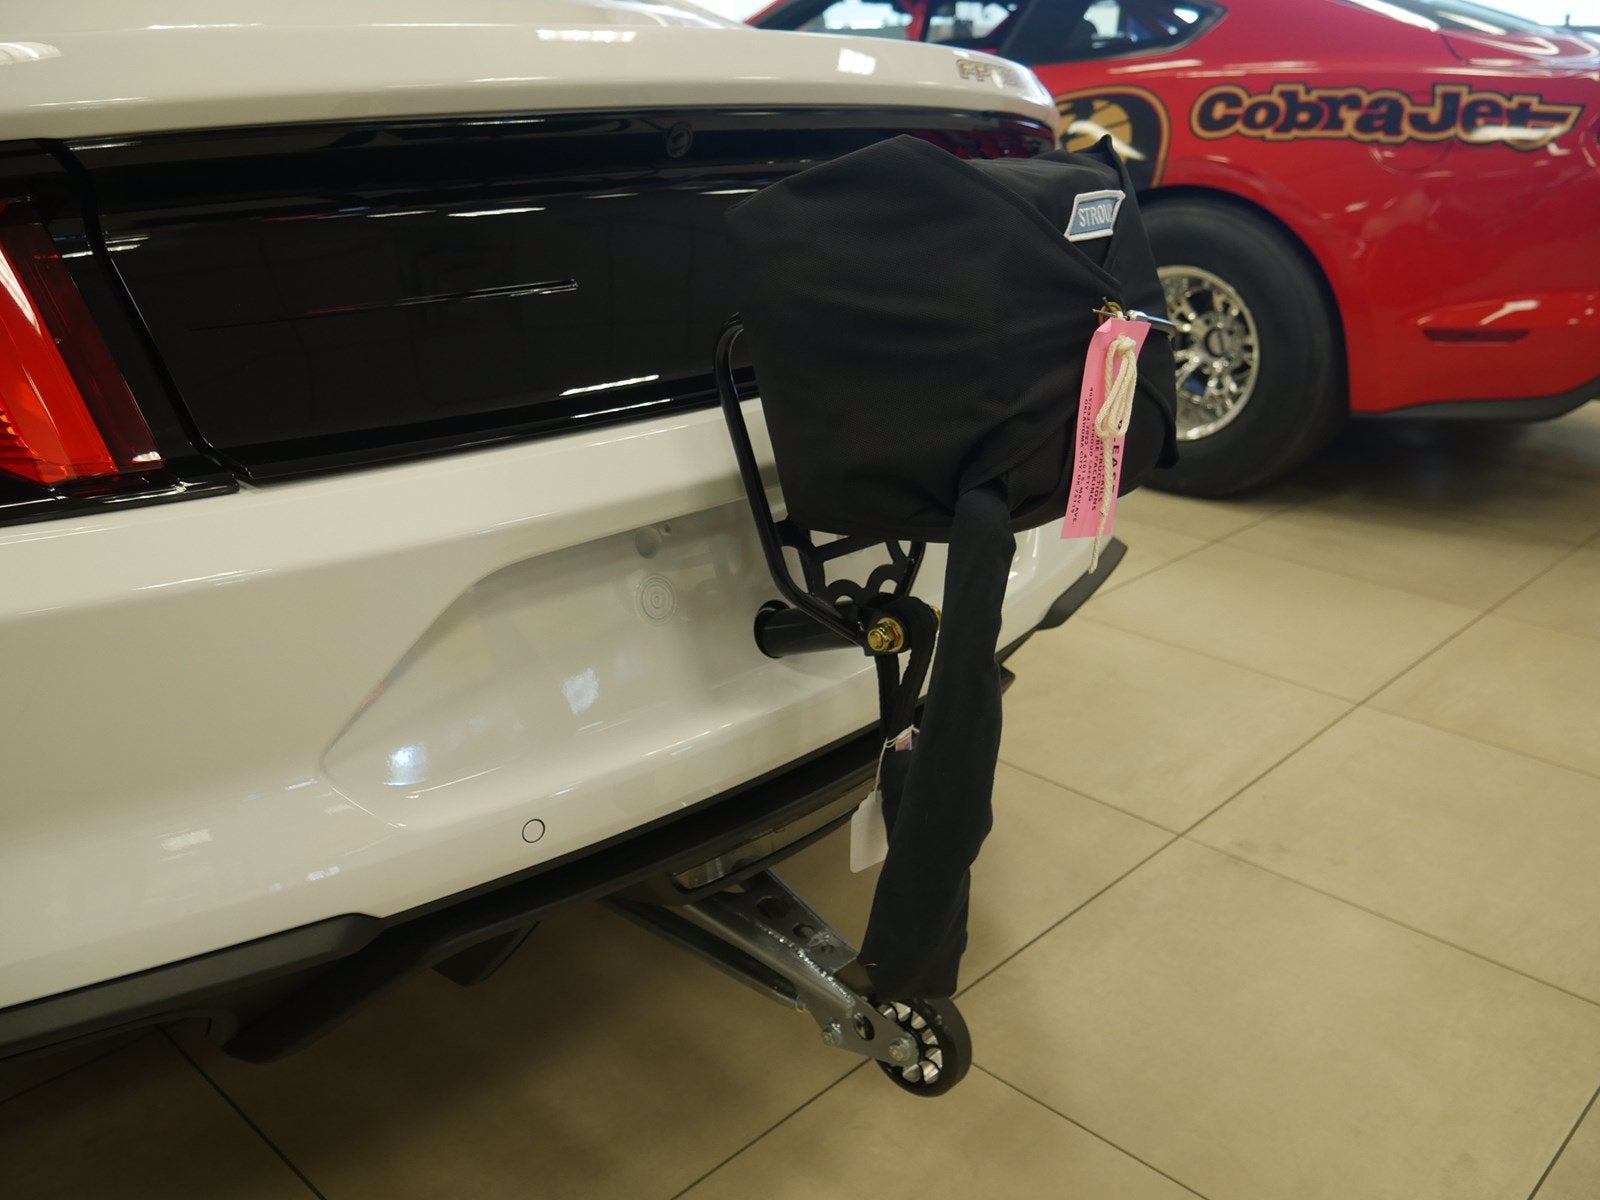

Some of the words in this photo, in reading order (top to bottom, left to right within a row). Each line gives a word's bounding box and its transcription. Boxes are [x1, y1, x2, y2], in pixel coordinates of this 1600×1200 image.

[1080, 399, 1088, 448] OKLAHOMA
[1088, 456, 1098, 502] PACKING
[1092, 438, 1104, 511] STRUCTIONS
